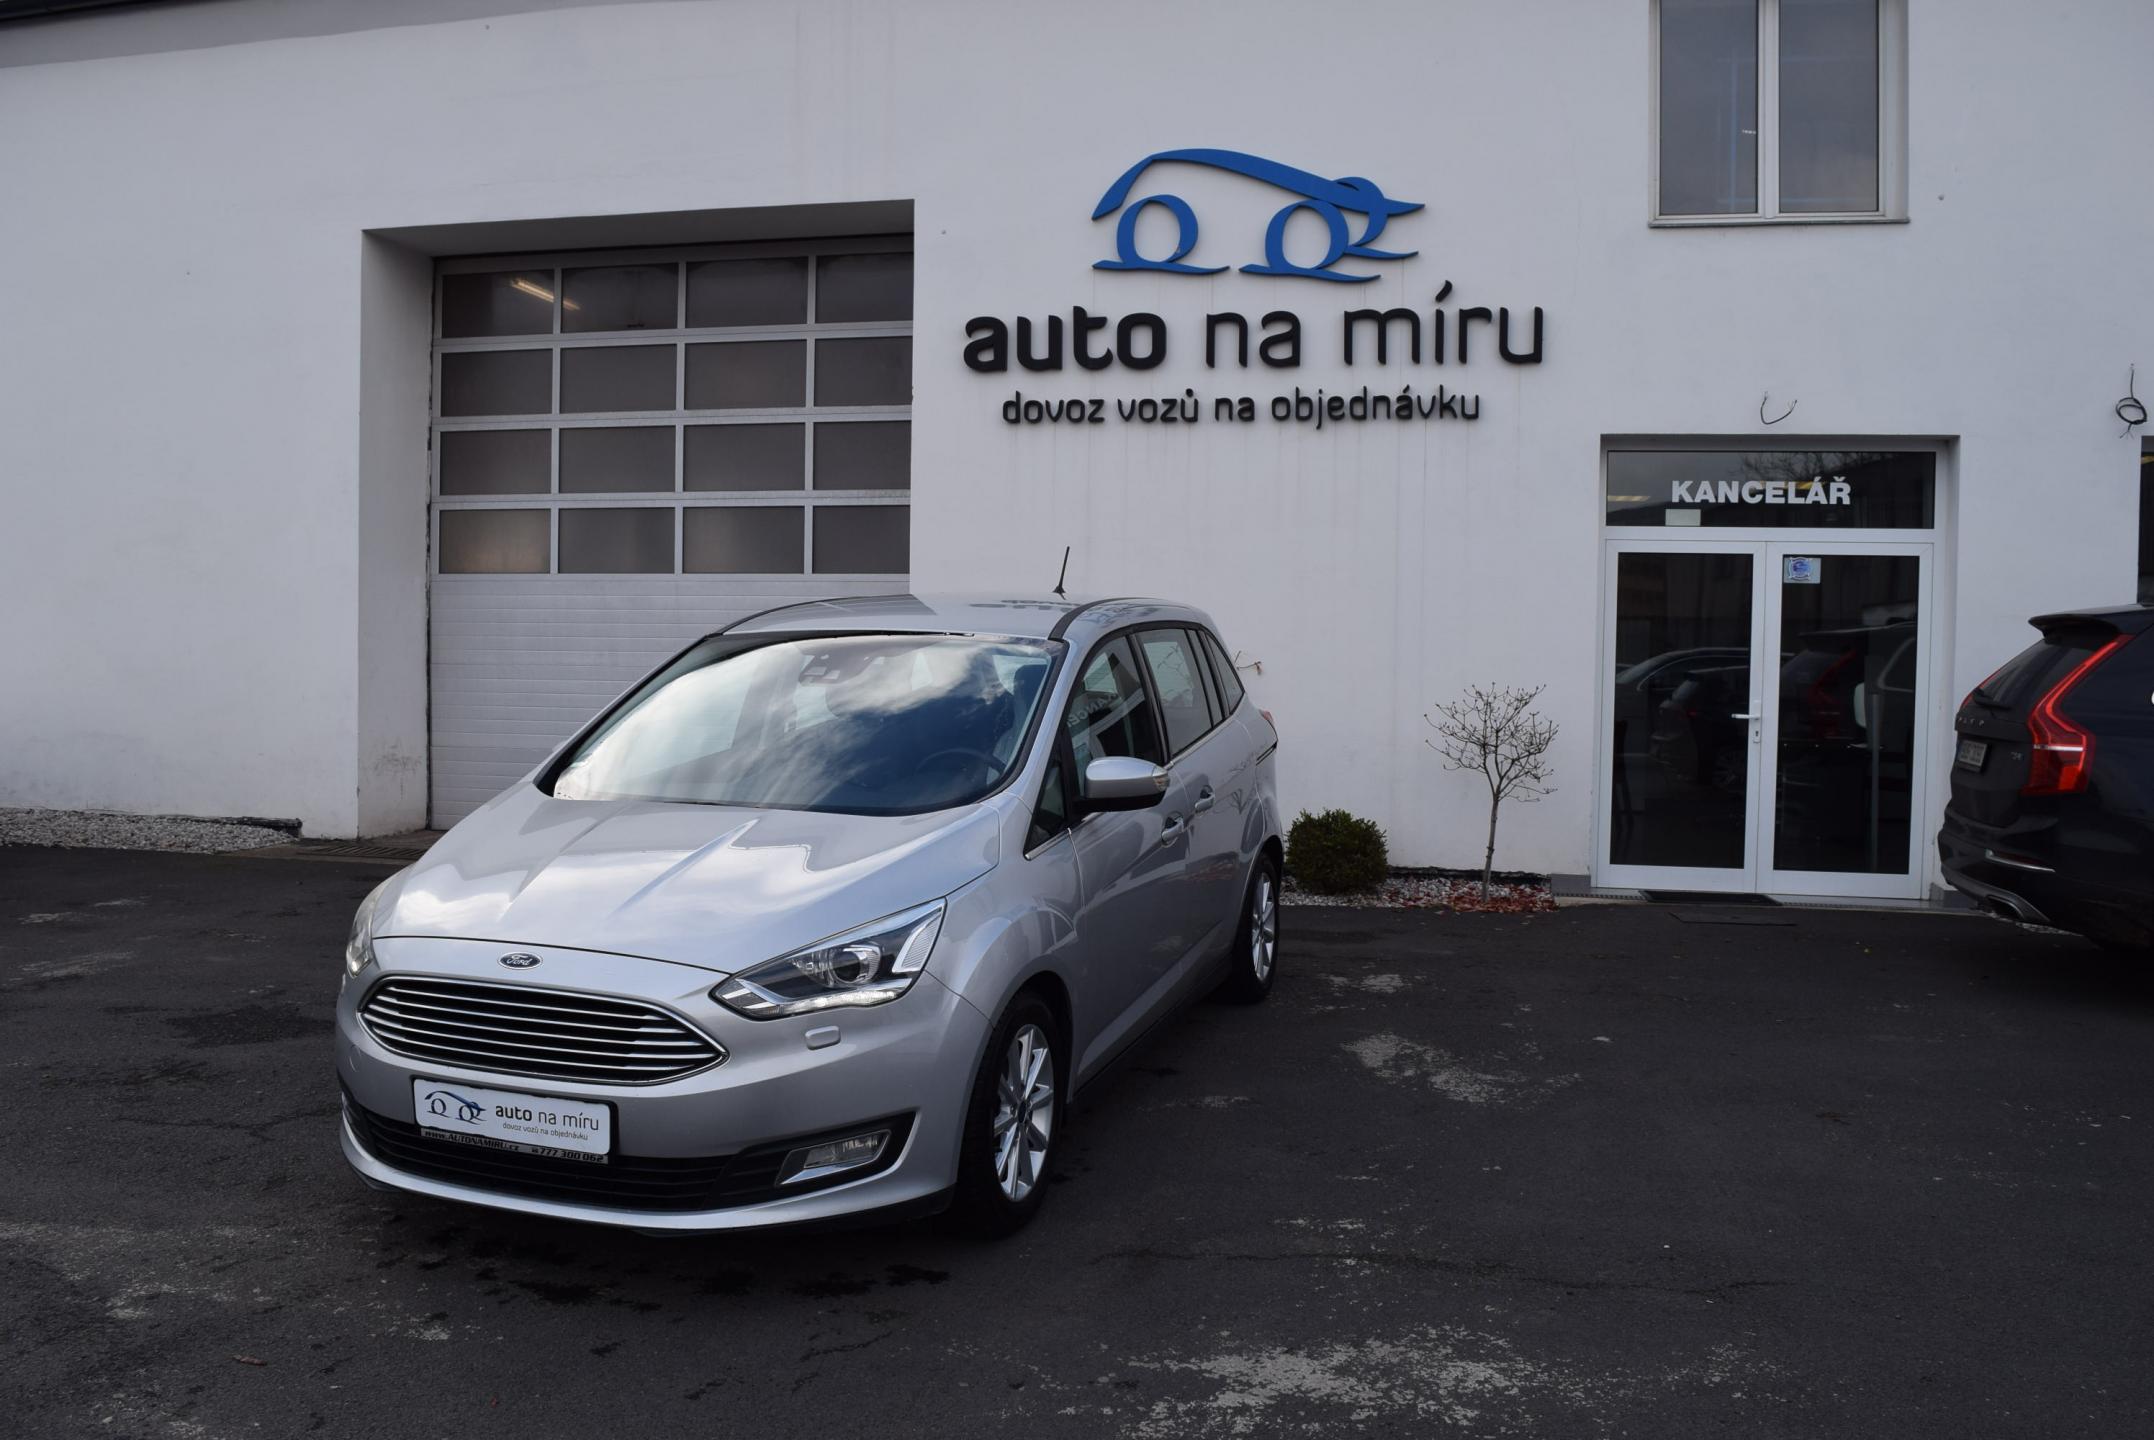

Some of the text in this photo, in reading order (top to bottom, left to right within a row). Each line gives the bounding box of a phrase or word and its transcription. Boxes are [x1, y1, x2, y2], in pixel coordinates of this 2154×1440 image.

[963, 279, 1544, 375] auto na míru
[1002, 384, 1480, 431] dovoz vozů na objednávku
[1671, 476, 1851, 505] KANCELÁŘ
[506, 954, 533, 966] Ford
[495, 1105, 599, 1131] auto na míru
[502, 1122, 522, 1132] dovoz
[541, 1147, 558, 1157] 777
[560, 1150, 580, 1160] 300
